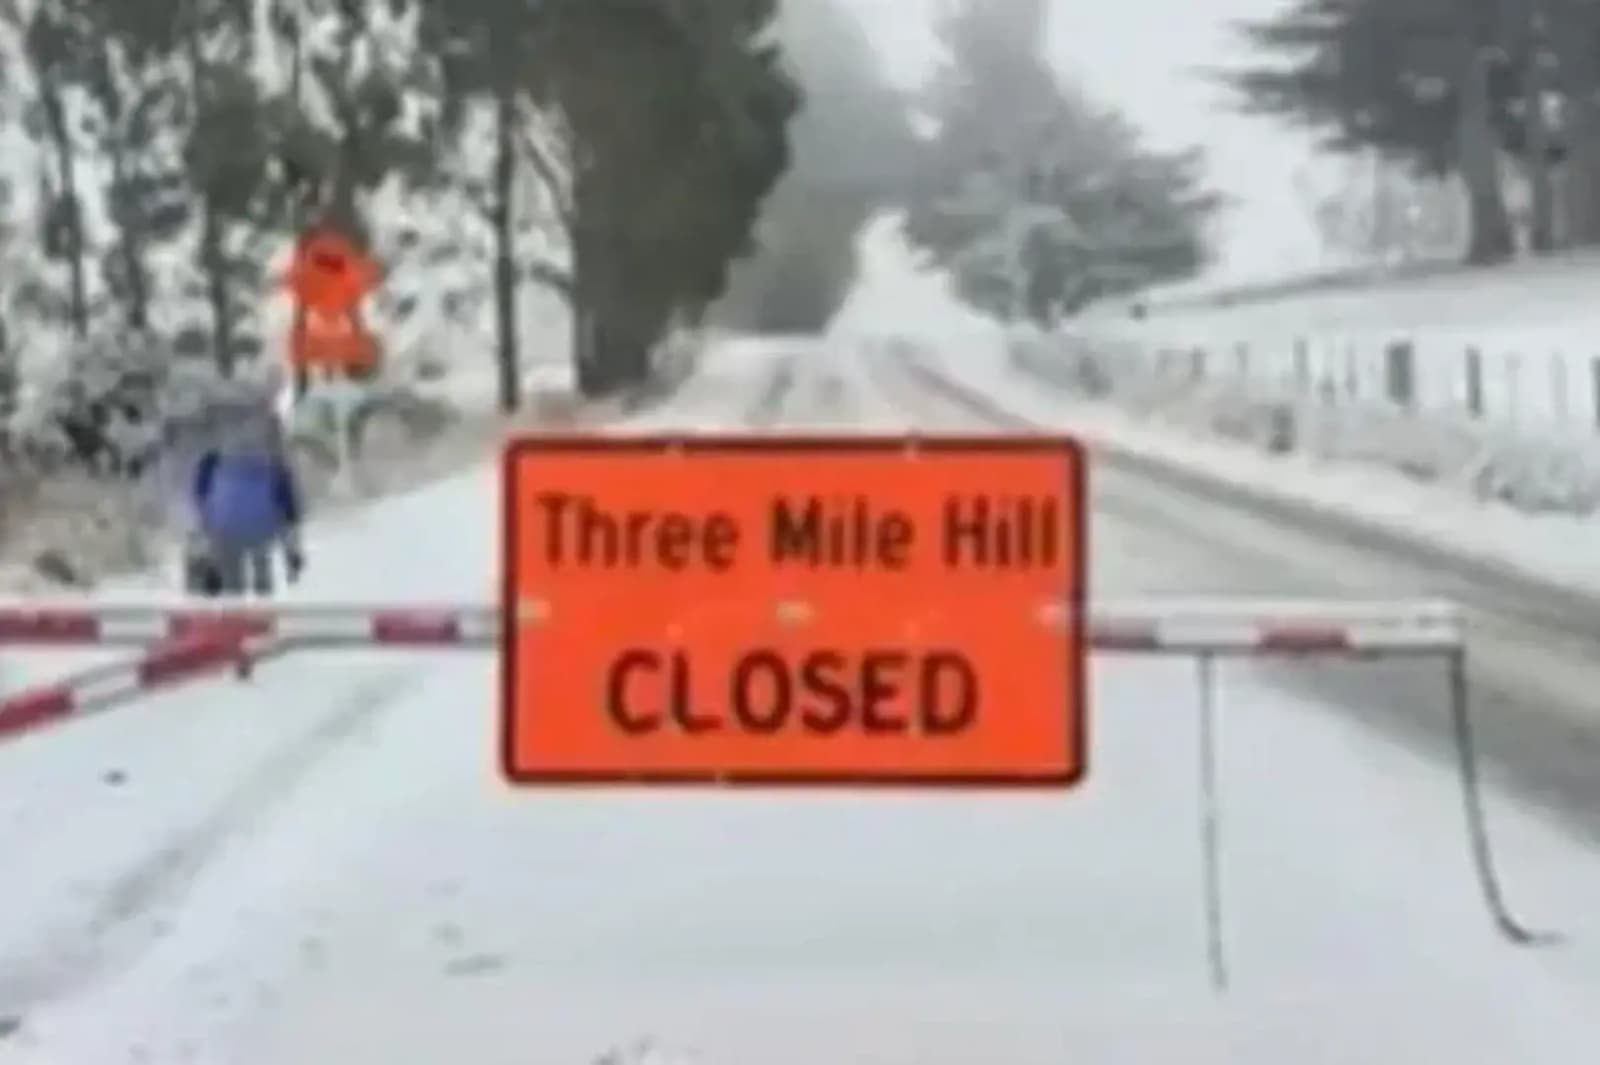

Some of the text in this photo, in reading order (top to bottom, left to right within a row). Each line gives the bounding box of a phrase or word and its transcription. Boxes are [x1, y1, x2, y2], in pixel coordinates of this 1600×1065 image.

[538, 493, 1057, 571] Three Mile Hill
[606, 648, 979, 736] CLOSED
